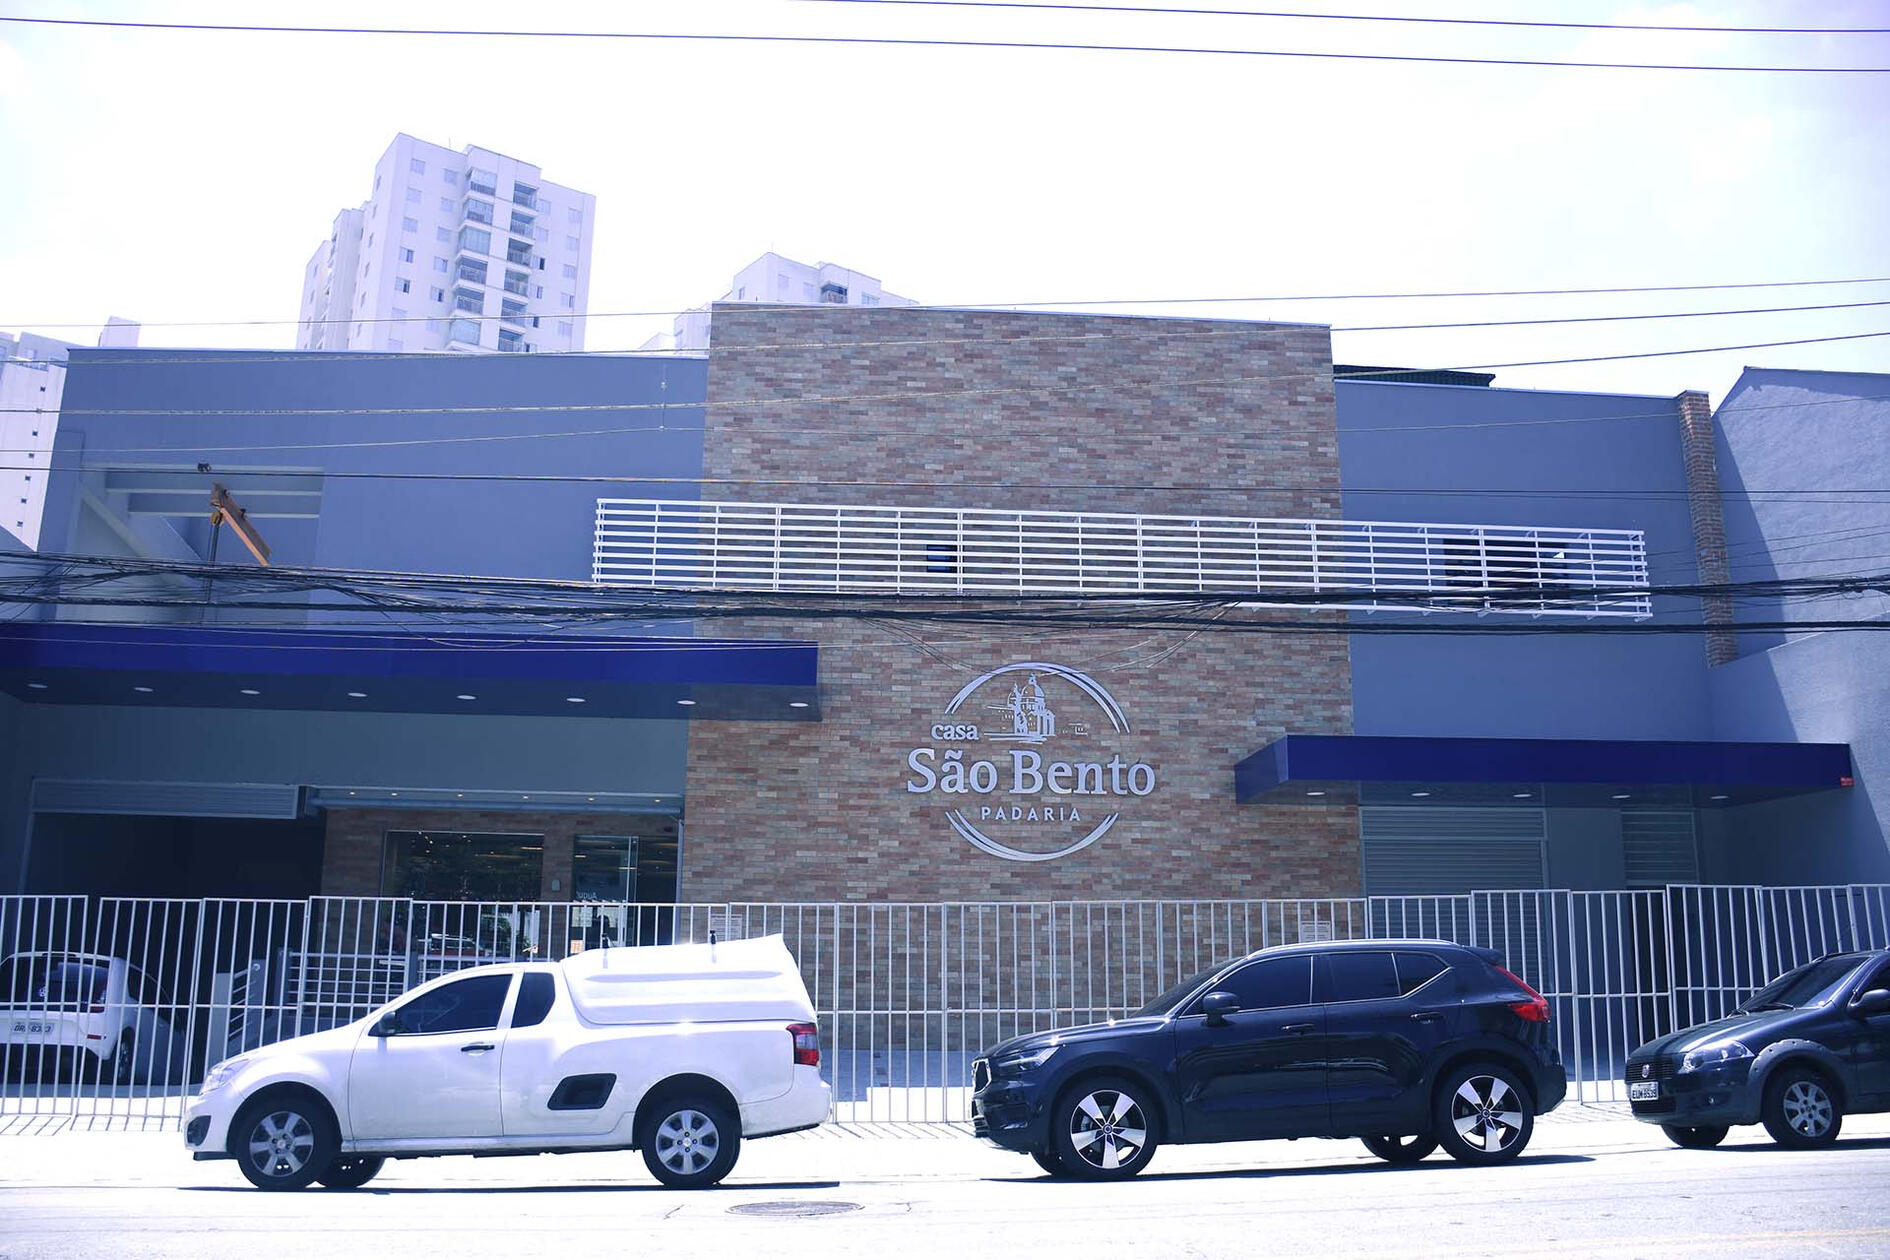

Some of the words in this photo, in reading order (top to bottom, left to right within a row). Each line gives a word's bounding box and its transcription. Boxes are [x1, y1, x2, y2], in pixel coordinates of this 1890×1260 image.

[931, 724, 979, 741] casa
[907, 748, 998, 794] São
[1009, 750, 1156, 796] Bento
[981, 806, 1080, 822] PADARIA
